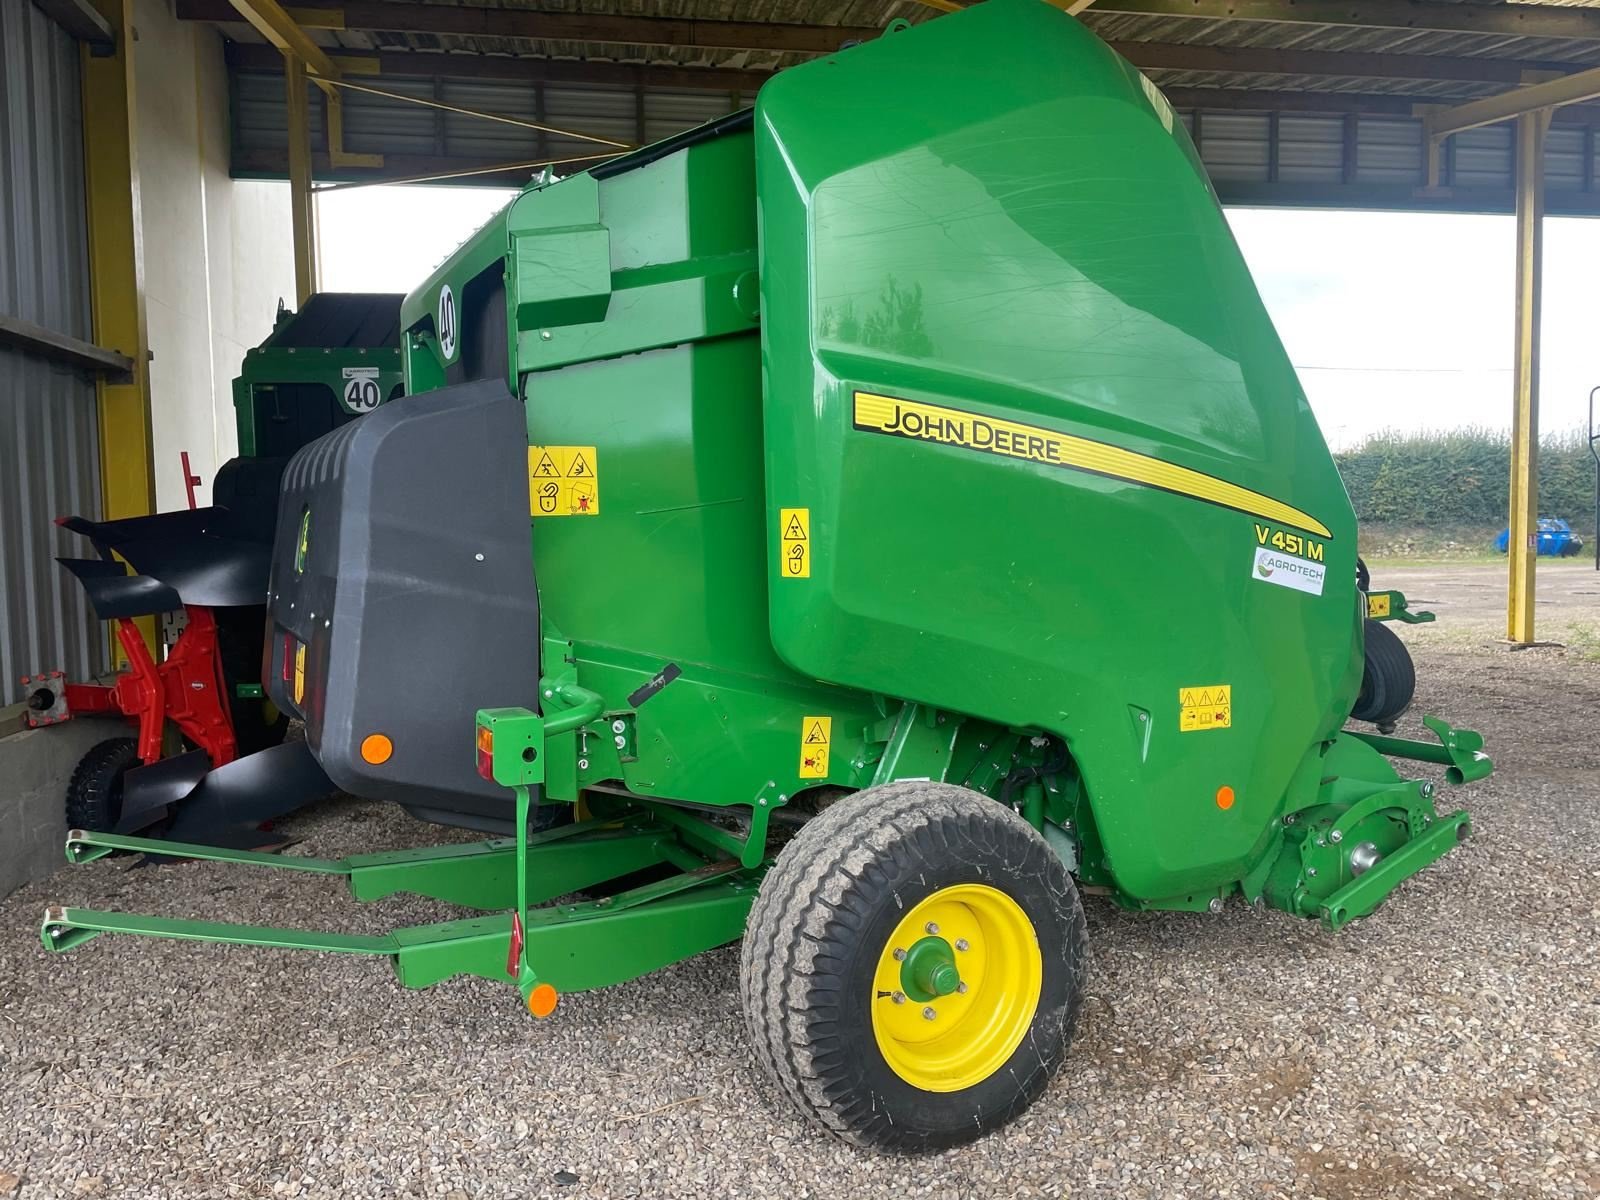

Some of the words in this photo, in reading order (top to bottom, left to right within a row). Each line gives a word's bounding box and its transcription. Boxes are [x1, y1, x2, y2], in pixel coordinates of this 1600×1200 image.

[441, 291, 455, 351] 40
[347, 381, 379, 409] 40
[884, 404, 965, 442] JOHN
[972, 420, 1061, 461] DEERE
[1255, 523, 1270, 545] V
[1271, 530, 1304, 556] 451
[1306, 540, 1323, 562] M
[1267, 557, 1324, 580] AGROTECH
